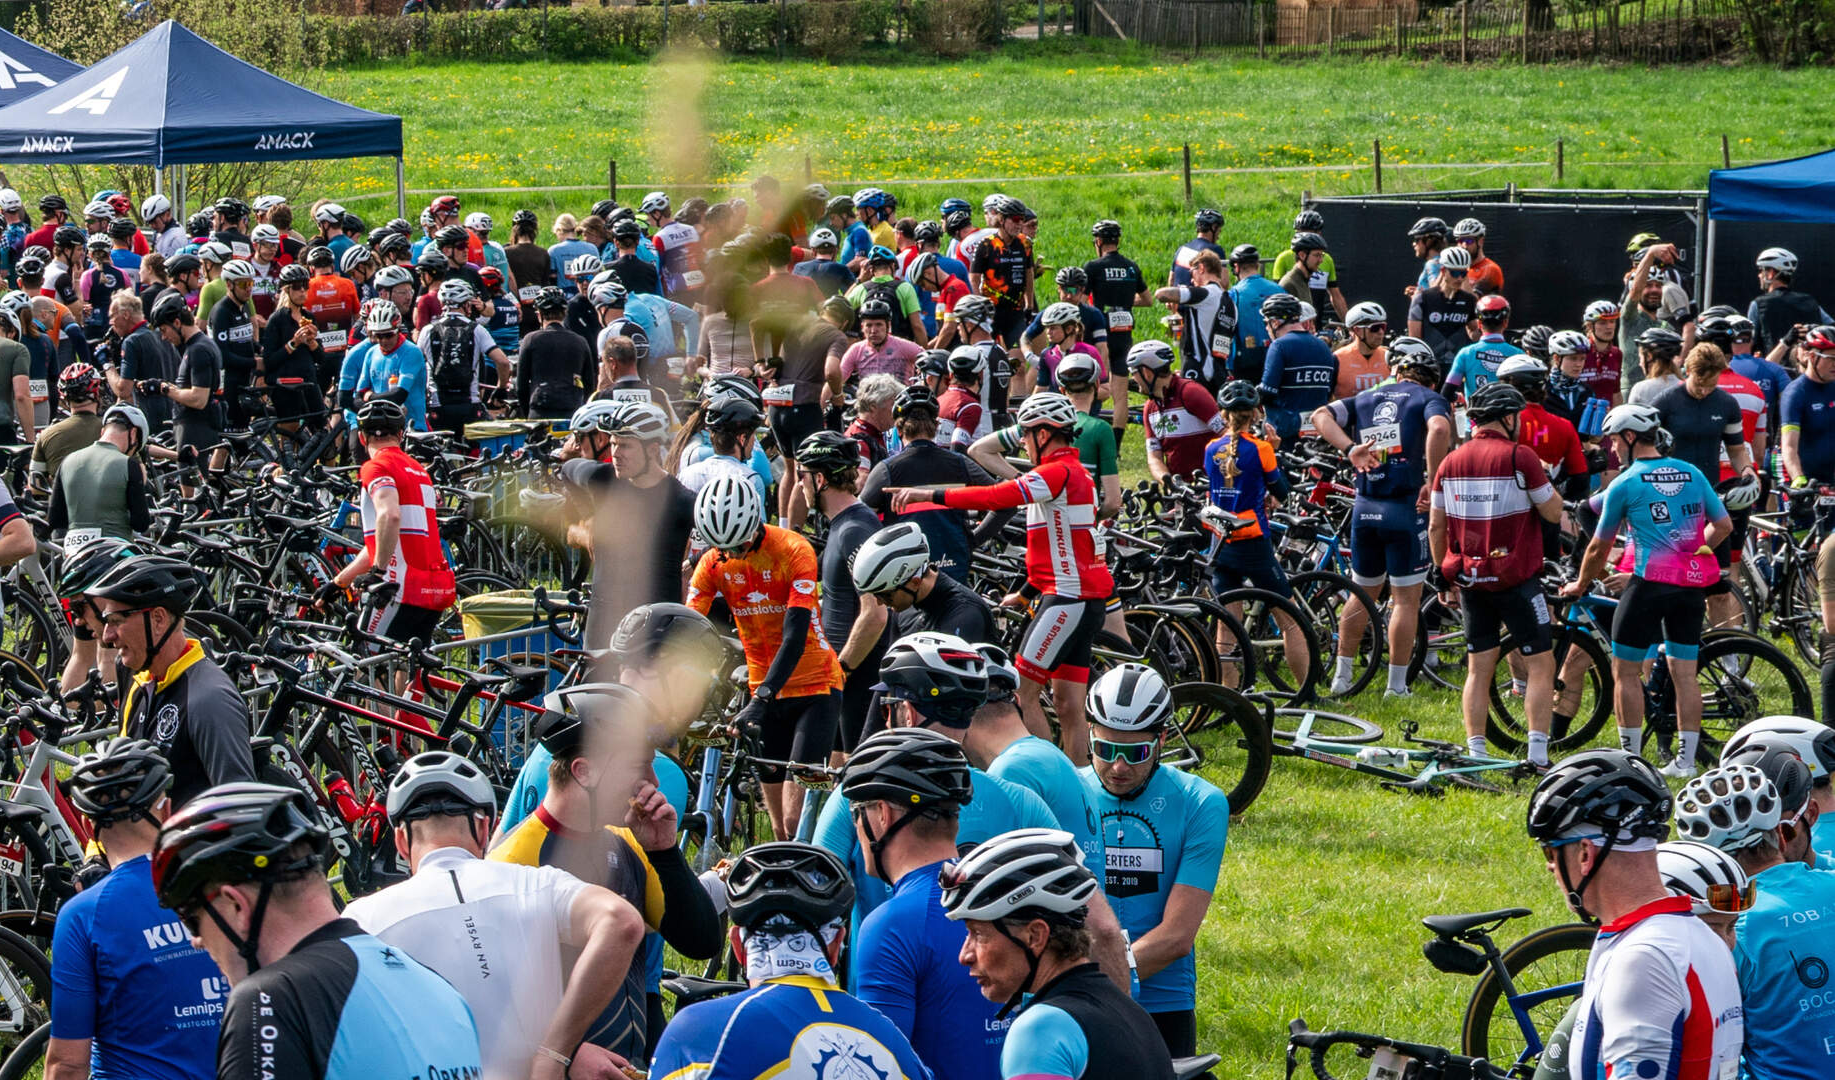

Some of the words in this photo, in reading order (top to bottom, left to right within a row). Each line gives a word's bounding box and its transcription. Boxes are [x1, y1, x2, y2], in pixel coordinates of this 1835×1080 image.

[20, 135, 75, 153] AMACX
[254, 132, 316, 150] AMACX
[1104, 268, 1127, 278] HTB
[1296, 372, 1311, 383] LE
[1052, 510, 1067, 558] MARKUS
[1061, 560, 1071, 575] BV
[1034, 624, 1061, 662] MARKUS
[1056, 610, 1069, 626] BV
[1105, 853, 1142, 868] ERTERS
[1120, 876, 1139, 886] 2019
[465, 915, 482, 950] RYSEL
[478, 952, 490, 979] VAN
[174, 1002, 224, 1018] Lennips
[260, 991, 275, 1017] DE
